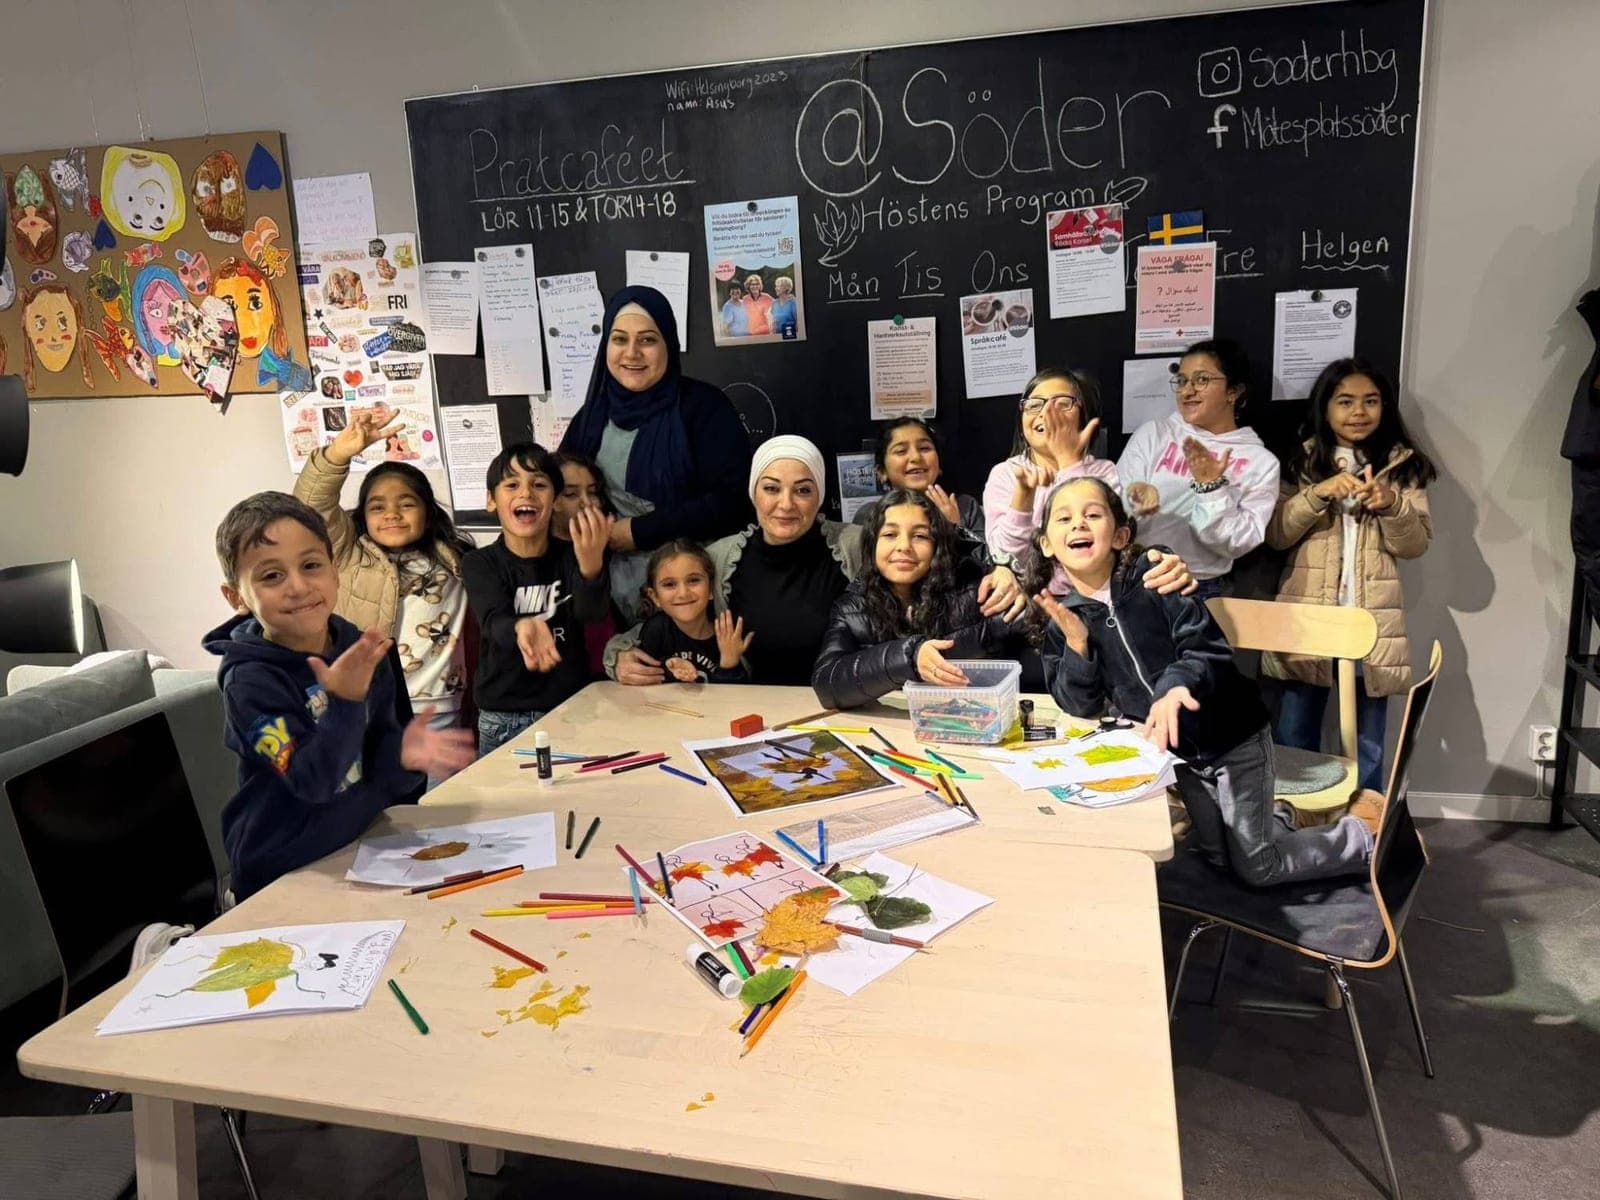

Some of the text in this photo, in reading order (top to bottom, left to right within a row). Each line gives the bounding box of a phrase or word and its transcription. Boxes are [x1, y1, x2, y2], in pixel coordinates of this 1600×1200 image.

[468, 119, 684, 198] Pratcaféet
[575, 196, 588, 222] &
[861, 185, 1095, 232] Höstens Program
[829, 272, 878, 297] Mån
[896, 251, 943, 293] Tis
[972, 250, 1029, 292] Ons
[1302, 229, 1389, 266] Helgen
[388, 294, 408, 309] FRI
[514, 580, 561, 616] NIKE
